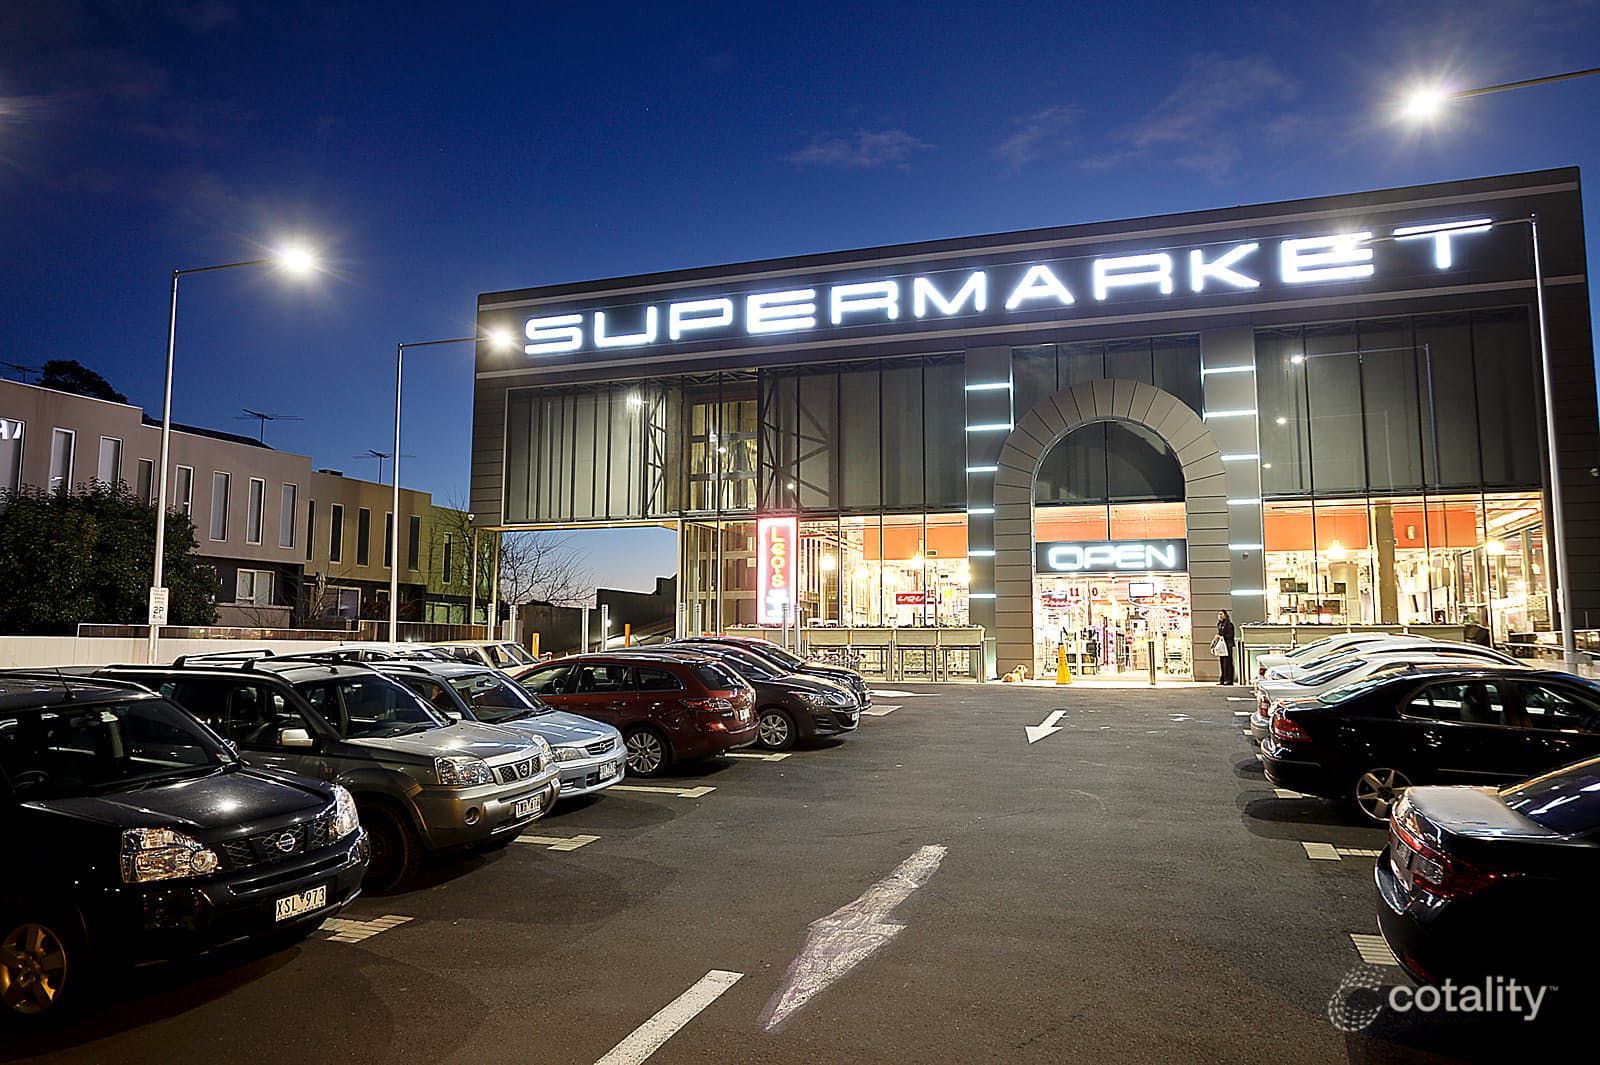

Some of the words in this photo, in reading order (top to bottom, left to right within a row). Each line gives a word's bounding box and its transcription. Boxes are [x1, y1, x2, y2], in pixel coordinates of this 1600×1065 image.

[524, 217, 1493, 355] SUPERMARKET
[1048, 544, 1176, 570] OPEN
[277, 896, 298, 916] XSL
[305, 888, 325, 906] 973
